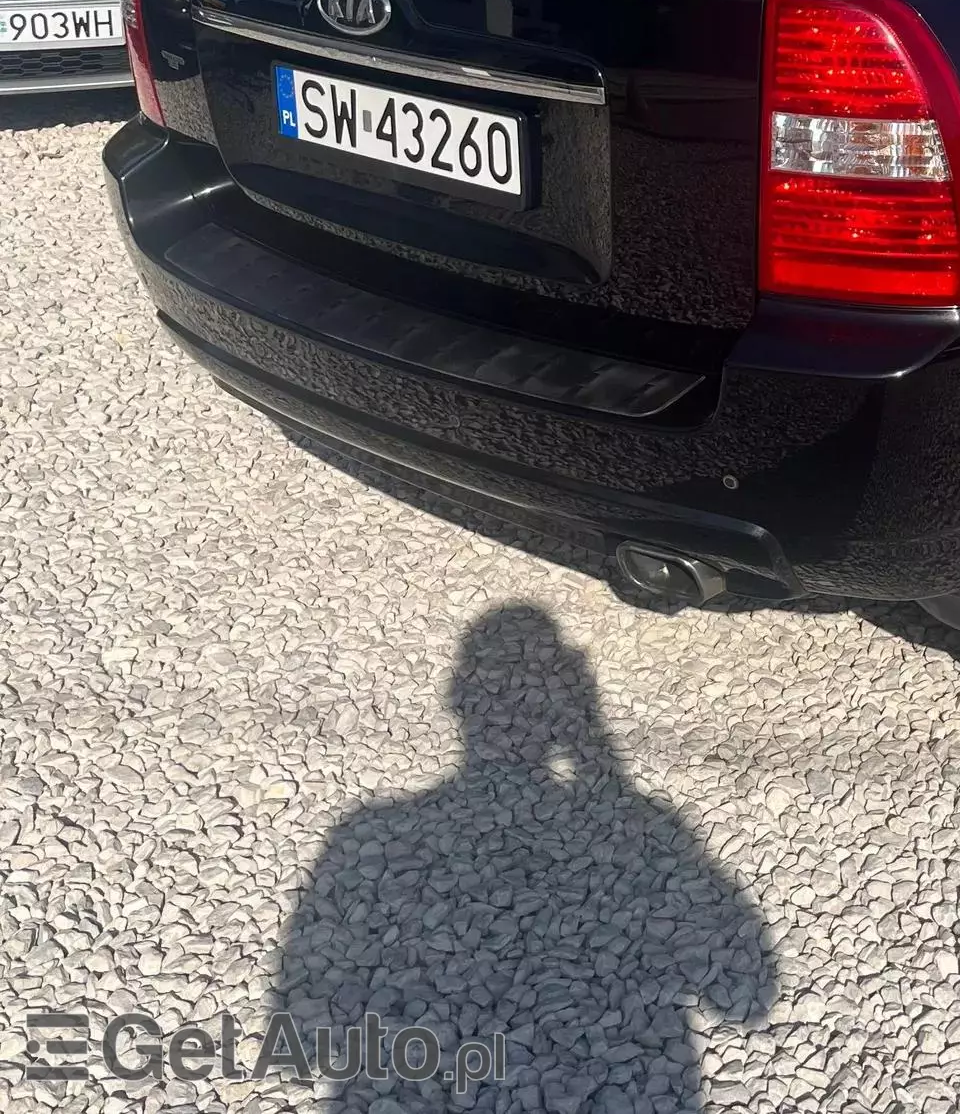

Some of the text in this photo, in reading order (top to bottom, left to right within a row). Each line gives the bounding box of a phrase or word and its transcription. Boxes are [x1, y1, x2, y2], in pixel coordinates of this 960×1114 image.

[10, 10, 113, 41] 903WH
[282, 109, 296, 127] PL
[301, 79, 513, 185] SW 43260
